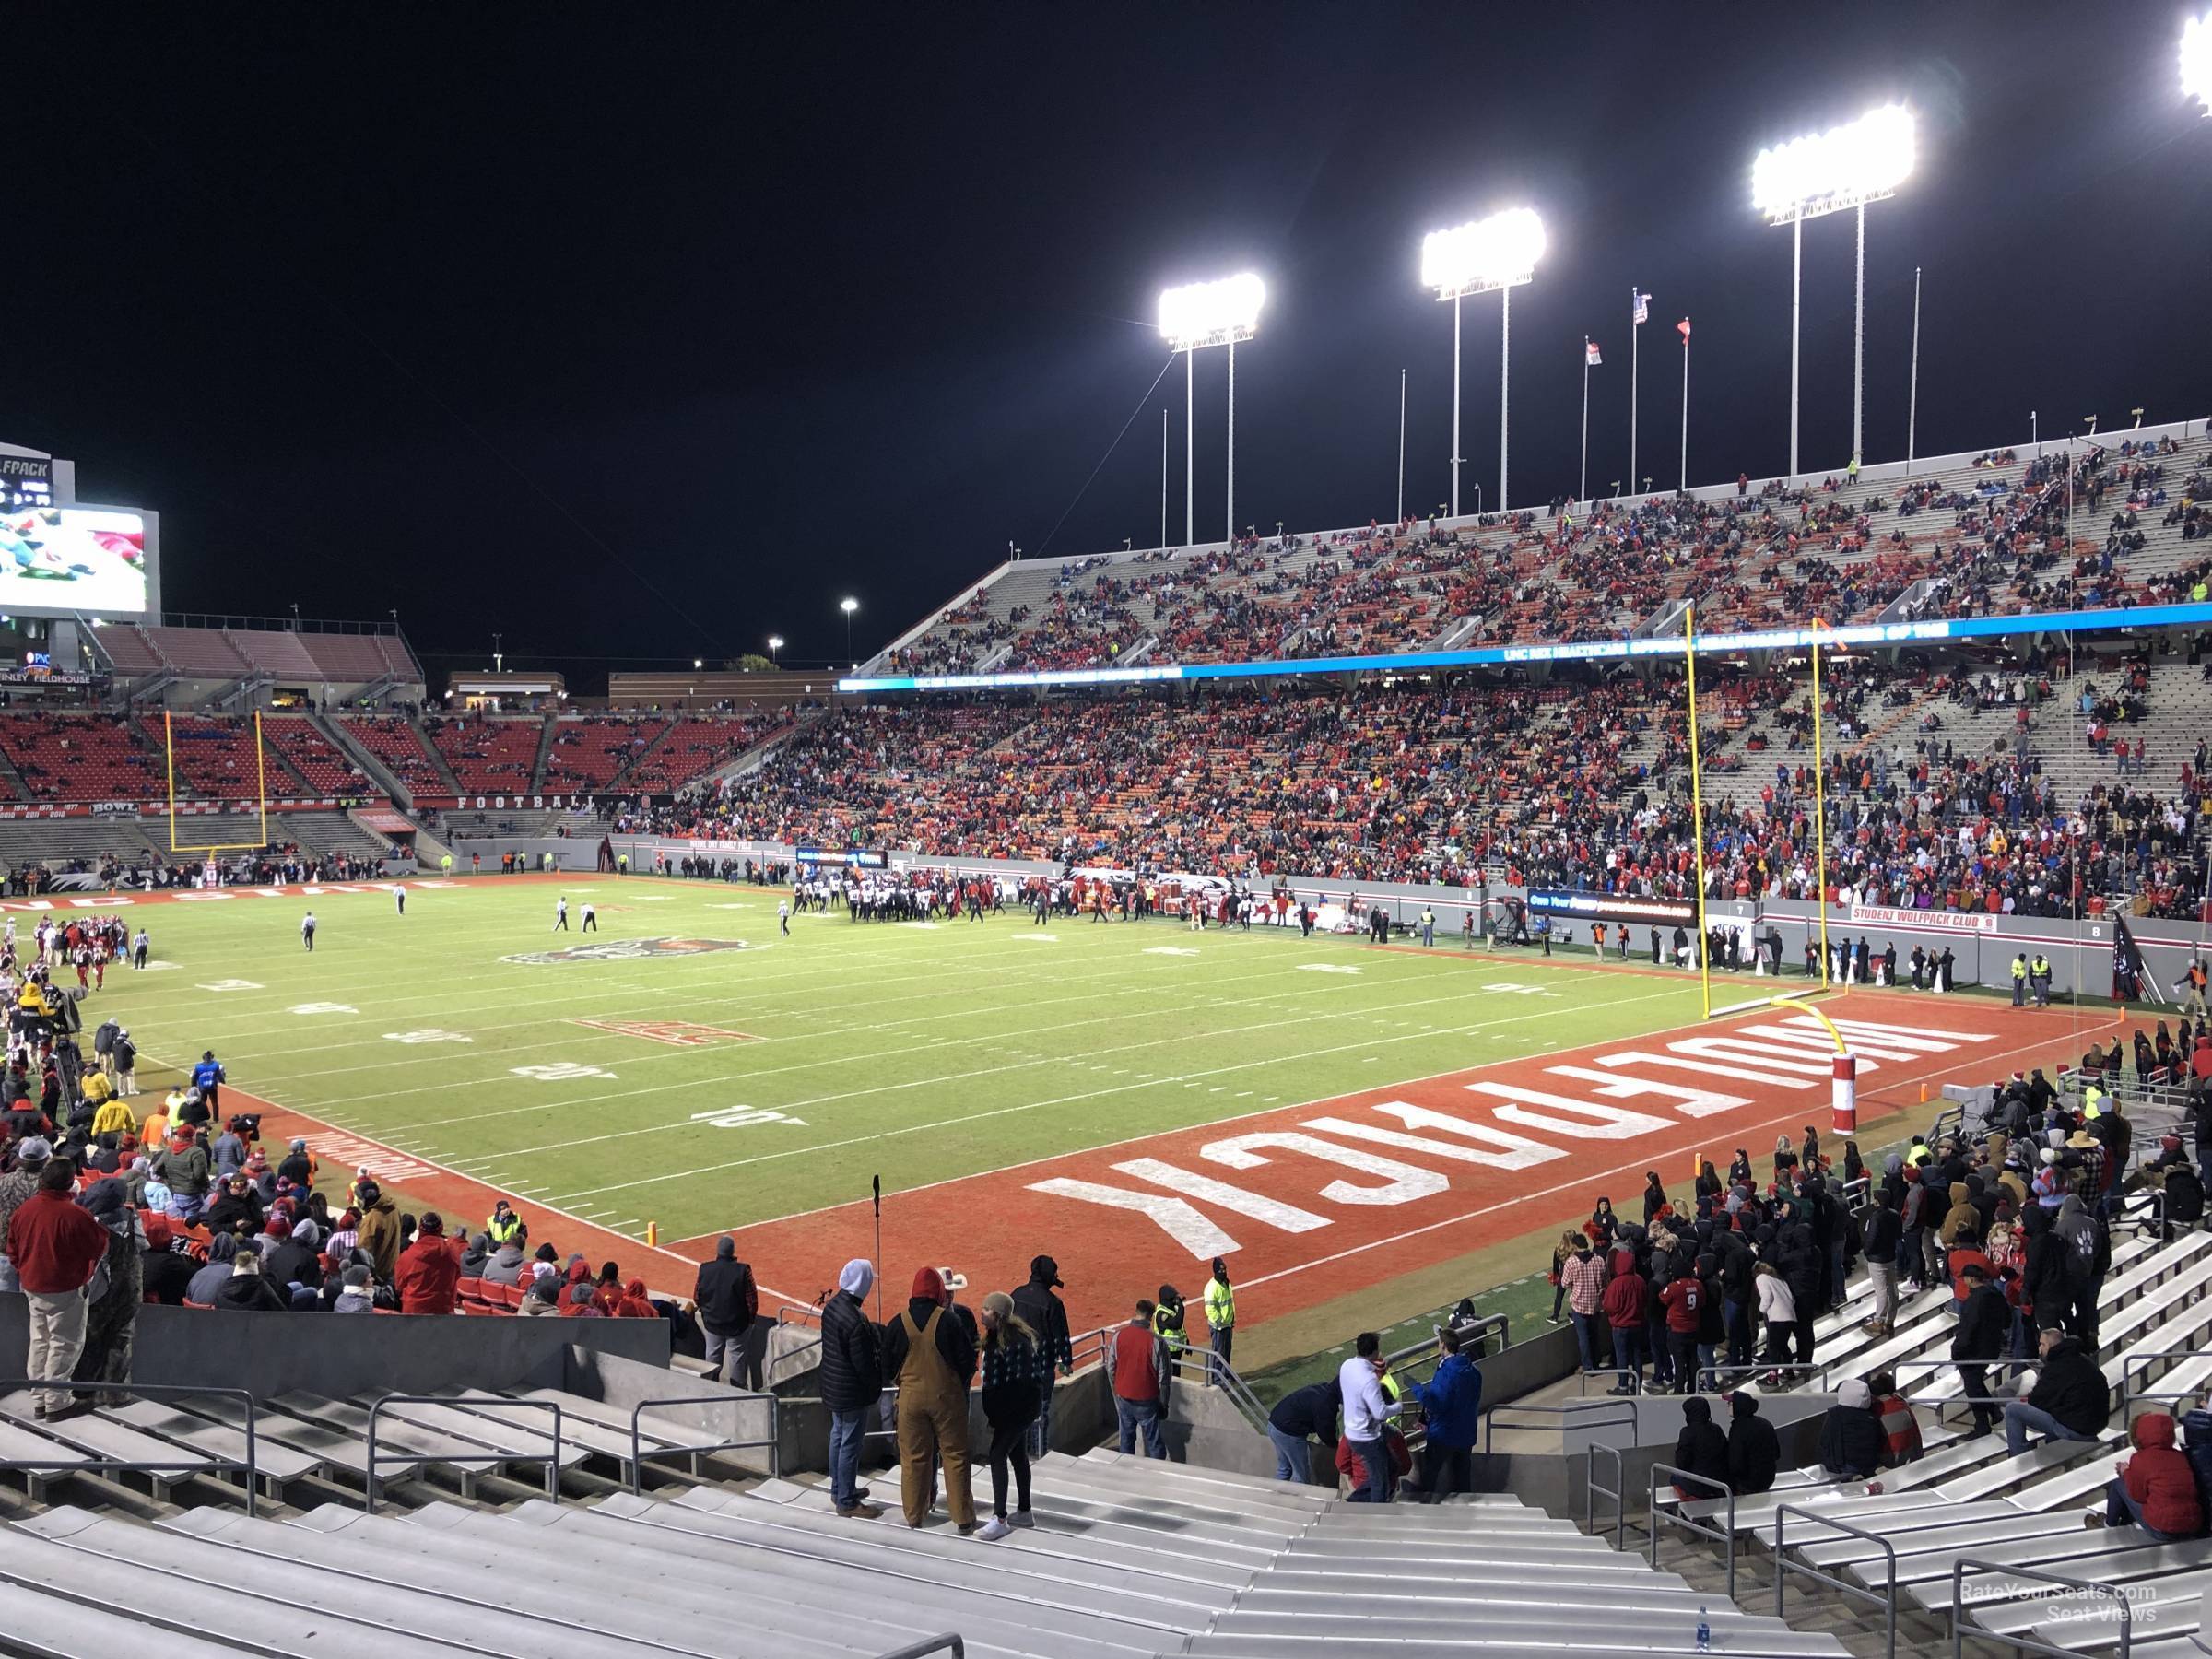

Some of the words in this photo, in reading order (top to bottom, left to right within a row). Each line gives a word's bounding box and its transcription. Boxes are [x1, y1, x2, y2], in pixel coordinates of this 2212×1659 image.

[0, 461, 48, 477] FPACK
[34, 675, 90, 684] FIELDHOUSE
[93, 803, 138, 812] BOWL
[458, 796, 595, 809] FOOTBALL
[171, 881, 468, 901] STATE
[1551, 897, 1570, 908] Your
[1737, 905, 1744, 915] 7
[1853, 908, 1894, 921] STUDENT
[1897, 911, 1951, 925] WOLFPACK
[1952, 916, 1979, 928] CLUB
[2092, 926, 2100, 936] 8
[508, 1062, 604, 1080] 20
[690, 1104, 787, 1127] 10
[1025, 1016, 2000, 1260] WOLFPACK
[1688, 1294, 1696, 1311] 9
